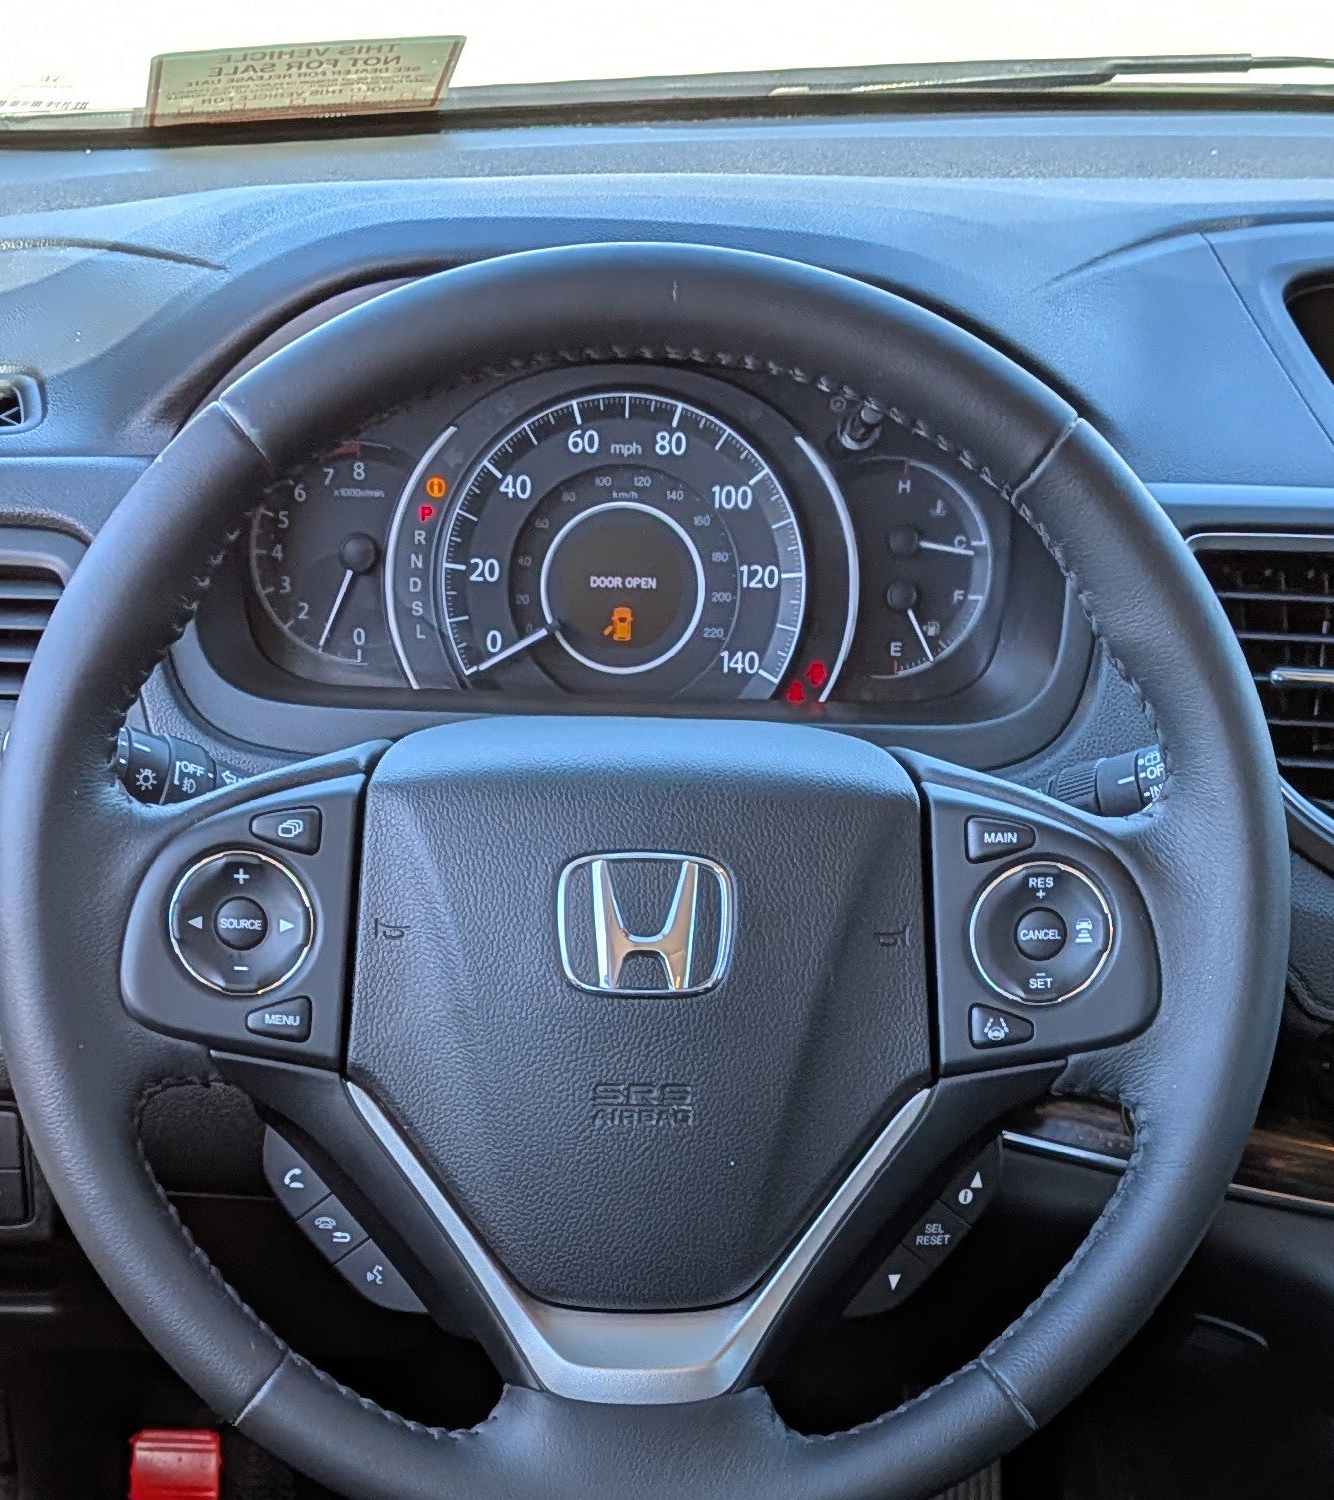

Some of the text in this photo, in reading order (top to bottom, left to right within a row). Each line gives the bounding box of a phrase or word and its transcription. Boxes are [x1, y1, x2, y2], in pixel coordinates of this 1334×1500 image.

[568, 430, 687, 456] 60 mph 80
[323, 467, 334, 486] 7
[353, 462, 365, 480] 8
[499, 475, 532, 499] 40
[595, 476, 612, 487] 100
[634, 476, 652, 487] 120
[898, 479, 911, 494] H
[294, 484, 306, 502] 6
[612, 490, 638, 500] km/h
[667, 490, 684, 501] 140
[712, 485, 752, 509] 100
[278, 510, 289, 528] 5
[420, 506, 432, 521] P
[414, 530, 426, 545] R
[954, 535, 967, 550] C
[271, 544, 282, 560] 4
[411, 554, 423, 569] N
[469, 558, 499, 581] 20
[740, 565, 778, 588] 120
[279, 576, 291, 594] 3
[410, 577, 421, 592] D
[590, 576, 657, 589] DOOR OPEN
[711, 592, 732, 602] 200
[953, 589, 965, 605] F
[298, 603, 309, 619] 2
[412, 601, 423, 616] S
[353, 628, 365, 645] 0
[416, 625, 426, 639] L
[703, 628, 724, 638] 220
[487, 631, 502, 652] 0
[890, 641, 902, 657] E
[720, 650, 759, 673] 140
[181, 760, 205, 777] OFF
[984, 832, 1017, 843] MAIN
[1028, 877, 1054, 889] RES
[220, 917, 262, 931] SOURCE
[1020, 930, 1061, 940] CANCEL
[1029, 977, 1053, 989] SET
[265, 1013, 300, 1026] MENU
[593, 1083, 692, 1105] SRS
[925, 1223, 944, 1233] SEL
[916, 1235, 951, 1245] RESET
